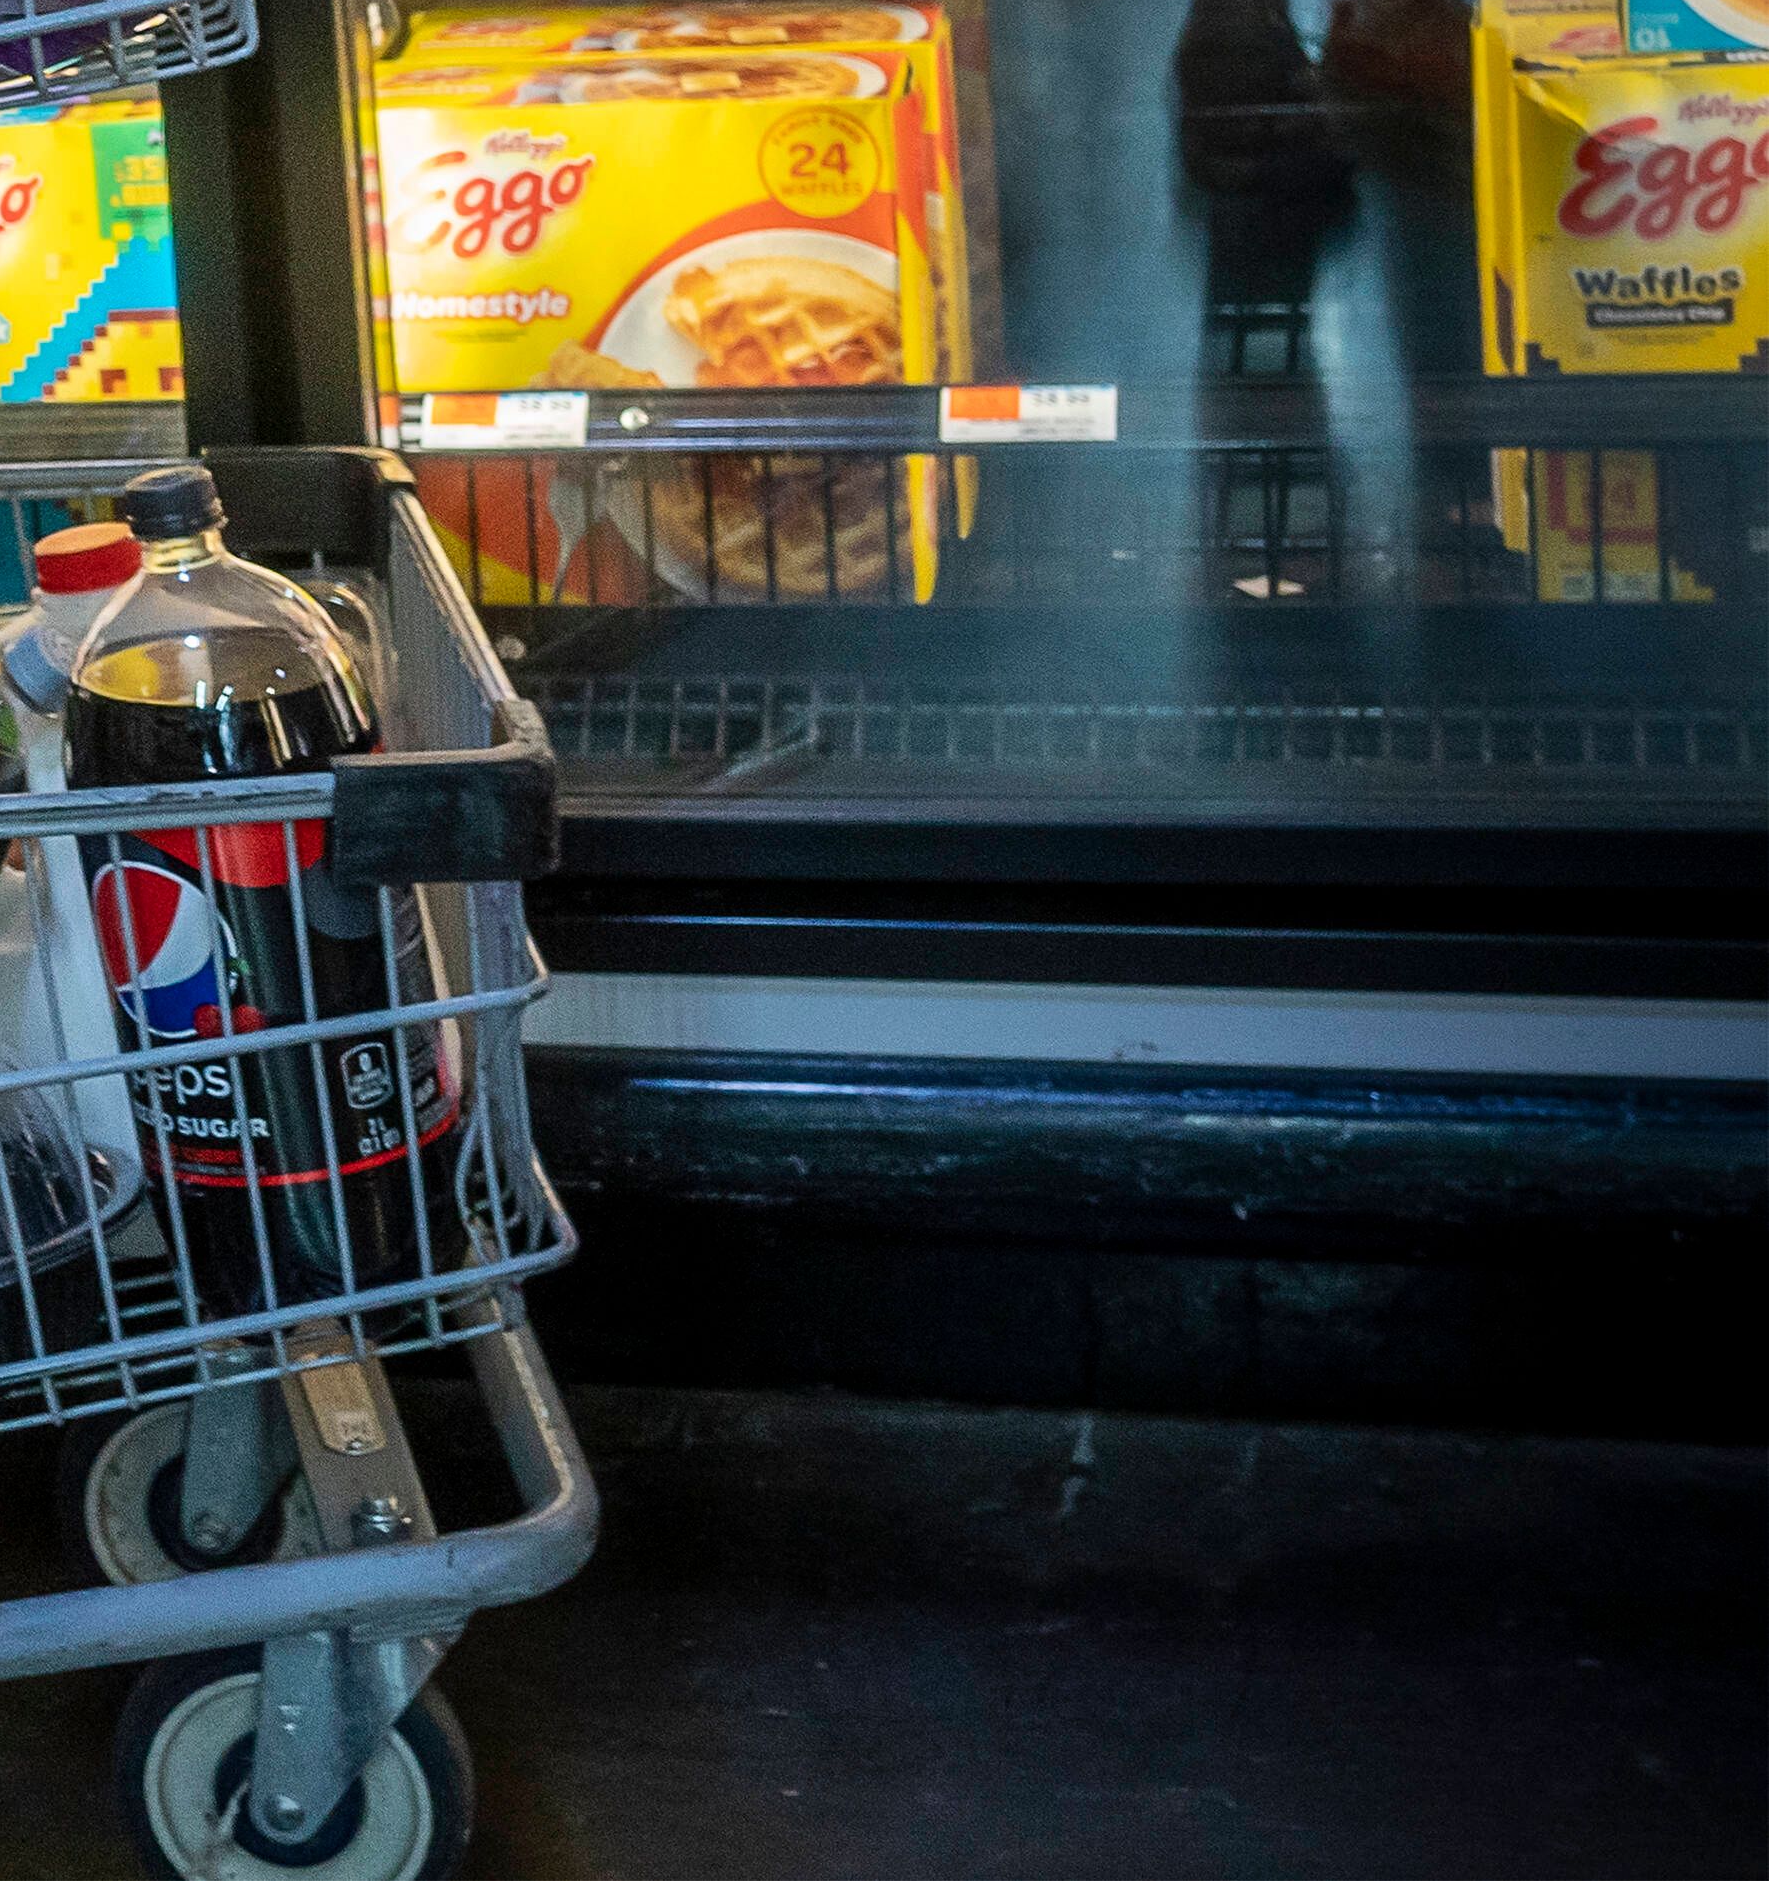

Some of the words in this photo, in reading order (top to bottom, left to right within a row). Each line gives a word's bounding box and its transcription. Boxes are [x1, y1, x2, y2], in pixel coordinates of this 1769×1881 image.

[786, 139, 853, 179] 24
[390, 150, 593, 259] Eggo
[1574, 264, 1742, 299] Waffles
[392, 289, 571, 323] Homestyle
